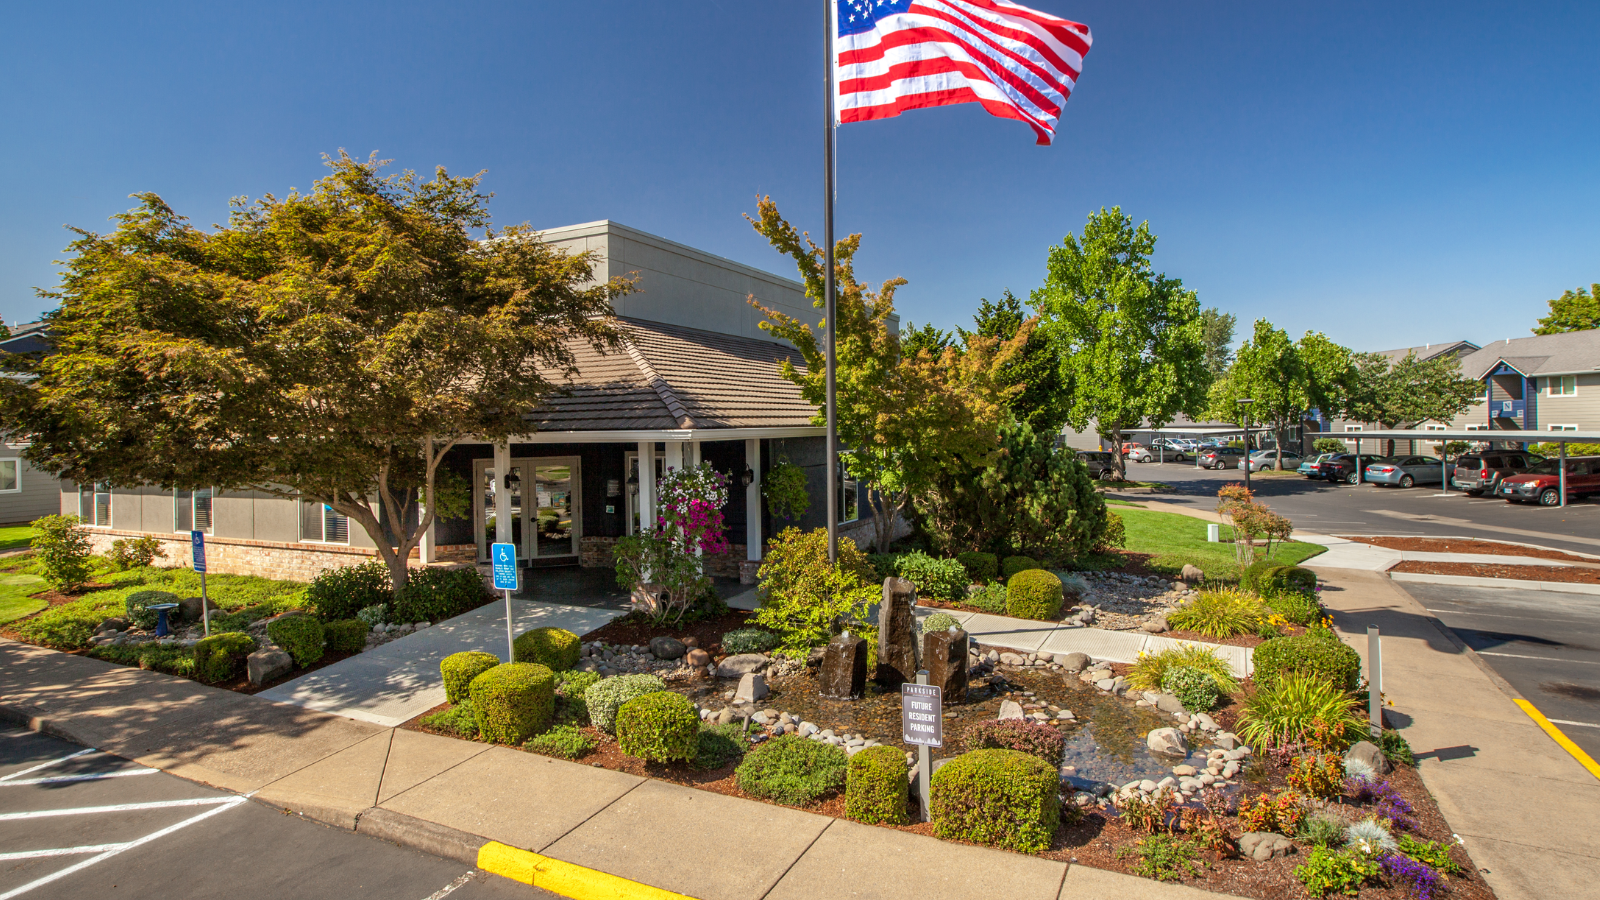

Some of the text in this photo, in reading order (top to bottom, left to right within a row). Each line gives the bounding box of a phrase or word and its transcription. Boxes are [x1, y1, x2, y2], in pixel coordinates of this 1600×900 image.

[906, 686, 936, 695] PARKSIDE
[911, 701, 932, 711] FUTURE
[908, 711, 935, 722] RESIDENT
[910, 723, 934, 733] PARKING
